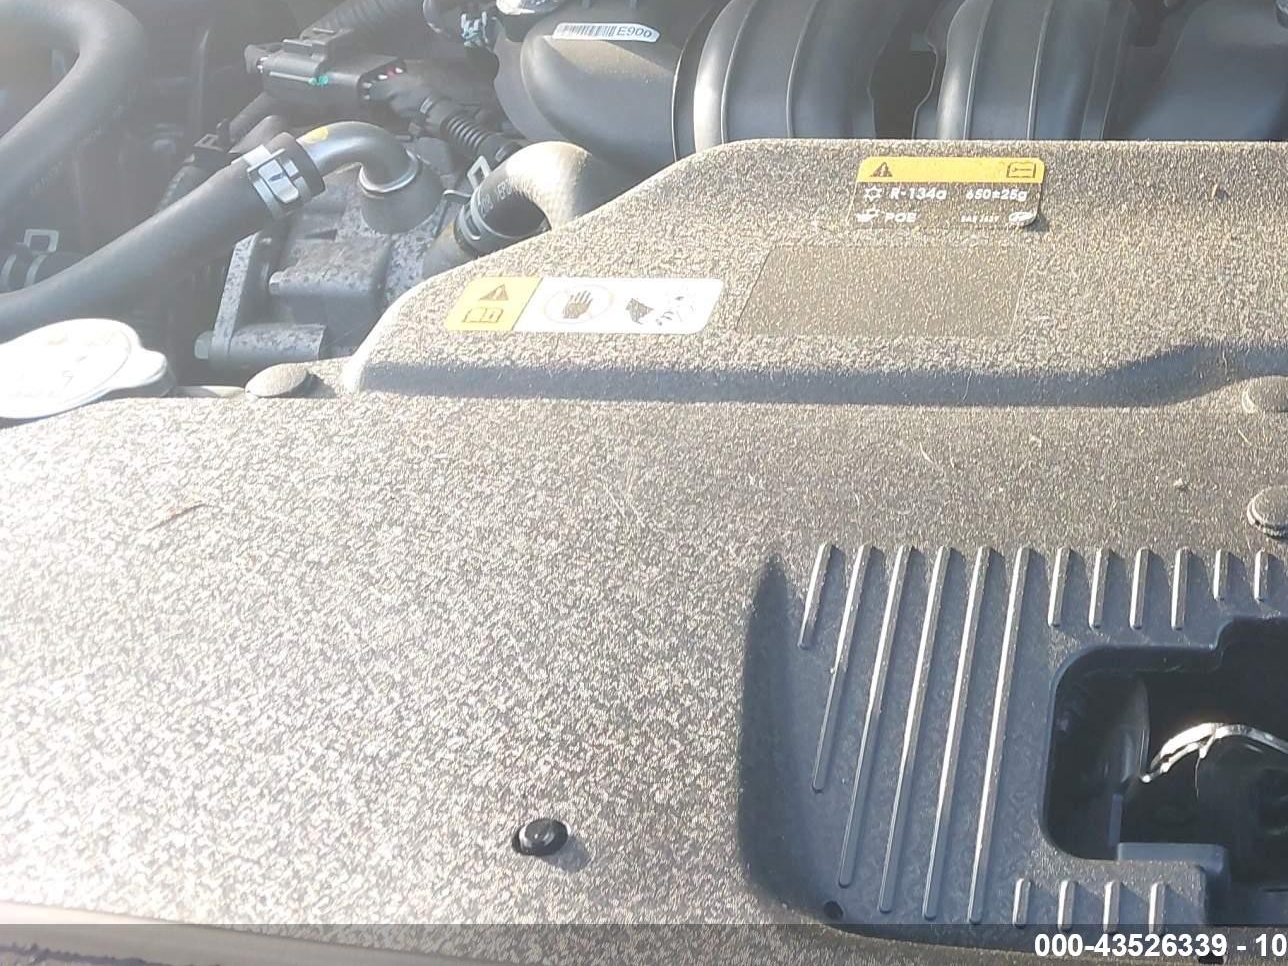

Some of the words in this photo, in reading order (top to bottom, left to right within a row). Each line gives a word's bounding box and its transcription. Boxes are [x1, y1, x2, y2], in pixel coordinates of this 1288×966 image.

[617, 26, 652, 38] E900
[890, 187, 947, 200] R-134a
[965, 188, 1028, 202] 650±25g
[884, 212, 917, 223] POE
